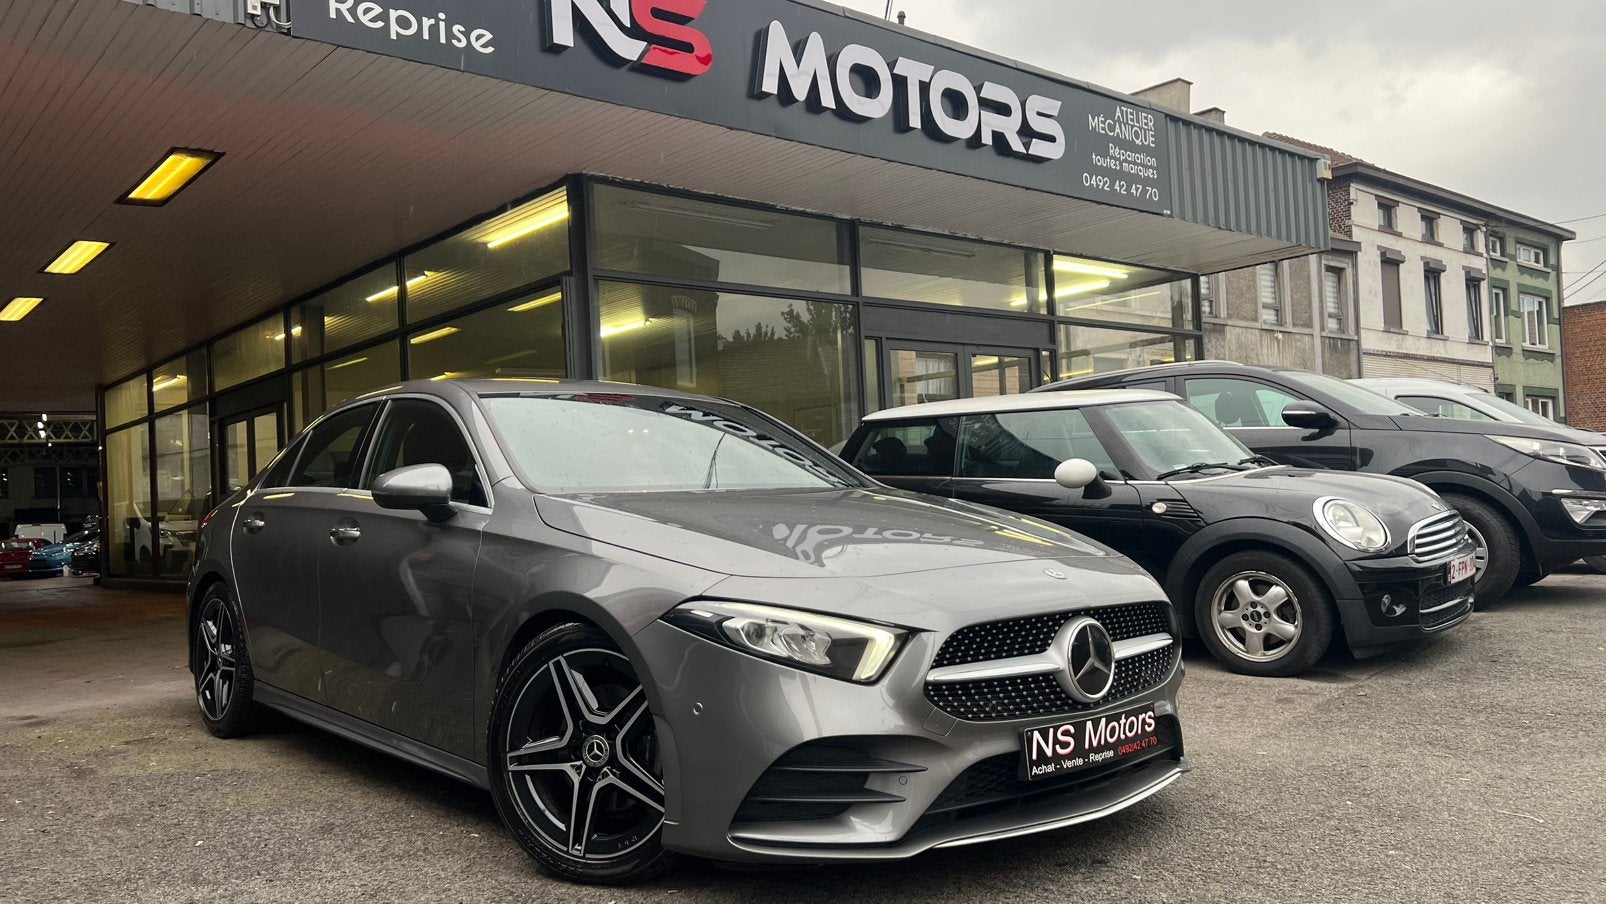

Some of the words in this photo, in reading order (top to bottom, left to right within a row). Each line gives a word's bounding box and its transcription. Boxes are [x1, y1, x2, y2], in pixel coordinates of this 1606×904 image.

[328, 0, 496, 54] Reprise
[759, 19, 1066, 160] MOTORS
[1088, 113, 1156, 147] MÉCANIQUE
[1114, 104, 1155, 131] ATELIER
[1092, 152, 1120, 170] toutes
[1122, 162, 1158, 179] marques
[1108, 142, 1157, 167] Réparation
[1082, 172, 1110, 191] 0492
[1114, 179, 1127, 195] 42
[1130, 183, 1143, 197] 47
[1146, 186, 1159, 201] 70
[1032, 724, 1076, 761] NS
[1084, 711, 1156, 750] Motors
[1031, 763, 1056, 776] Achat
[1061, 757, 1084, 770] Vente
[1089, 749, 1115, 763] Reprise
